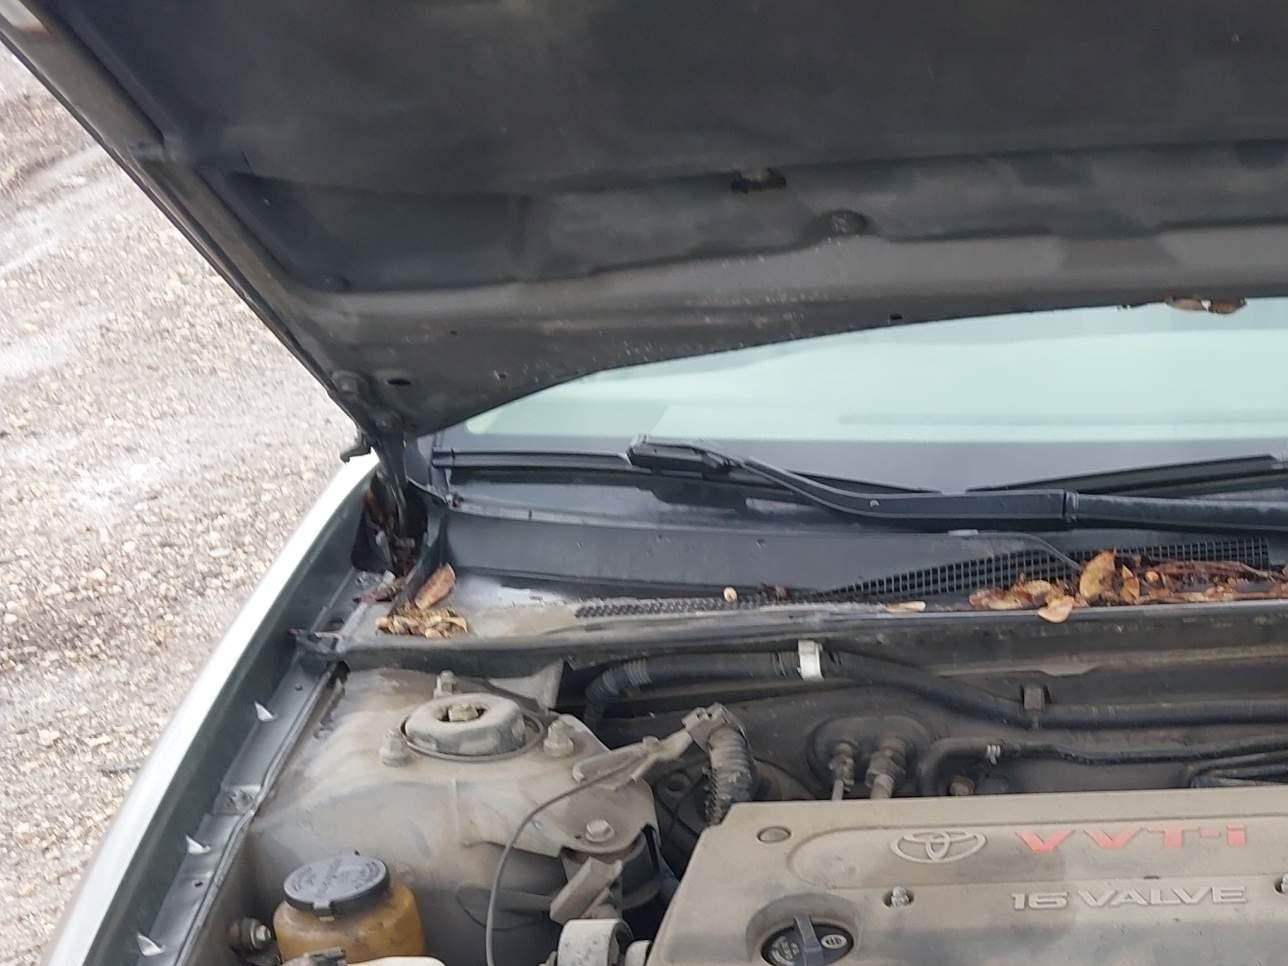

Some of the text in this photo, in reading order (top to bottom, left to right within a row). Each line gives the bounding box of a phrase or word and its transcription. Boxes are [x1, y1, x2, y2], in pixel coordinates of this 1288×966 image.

[1014, 823, 1249, 853] VVT-i
[1010, 886, 1249, 912] 16 VALVE
